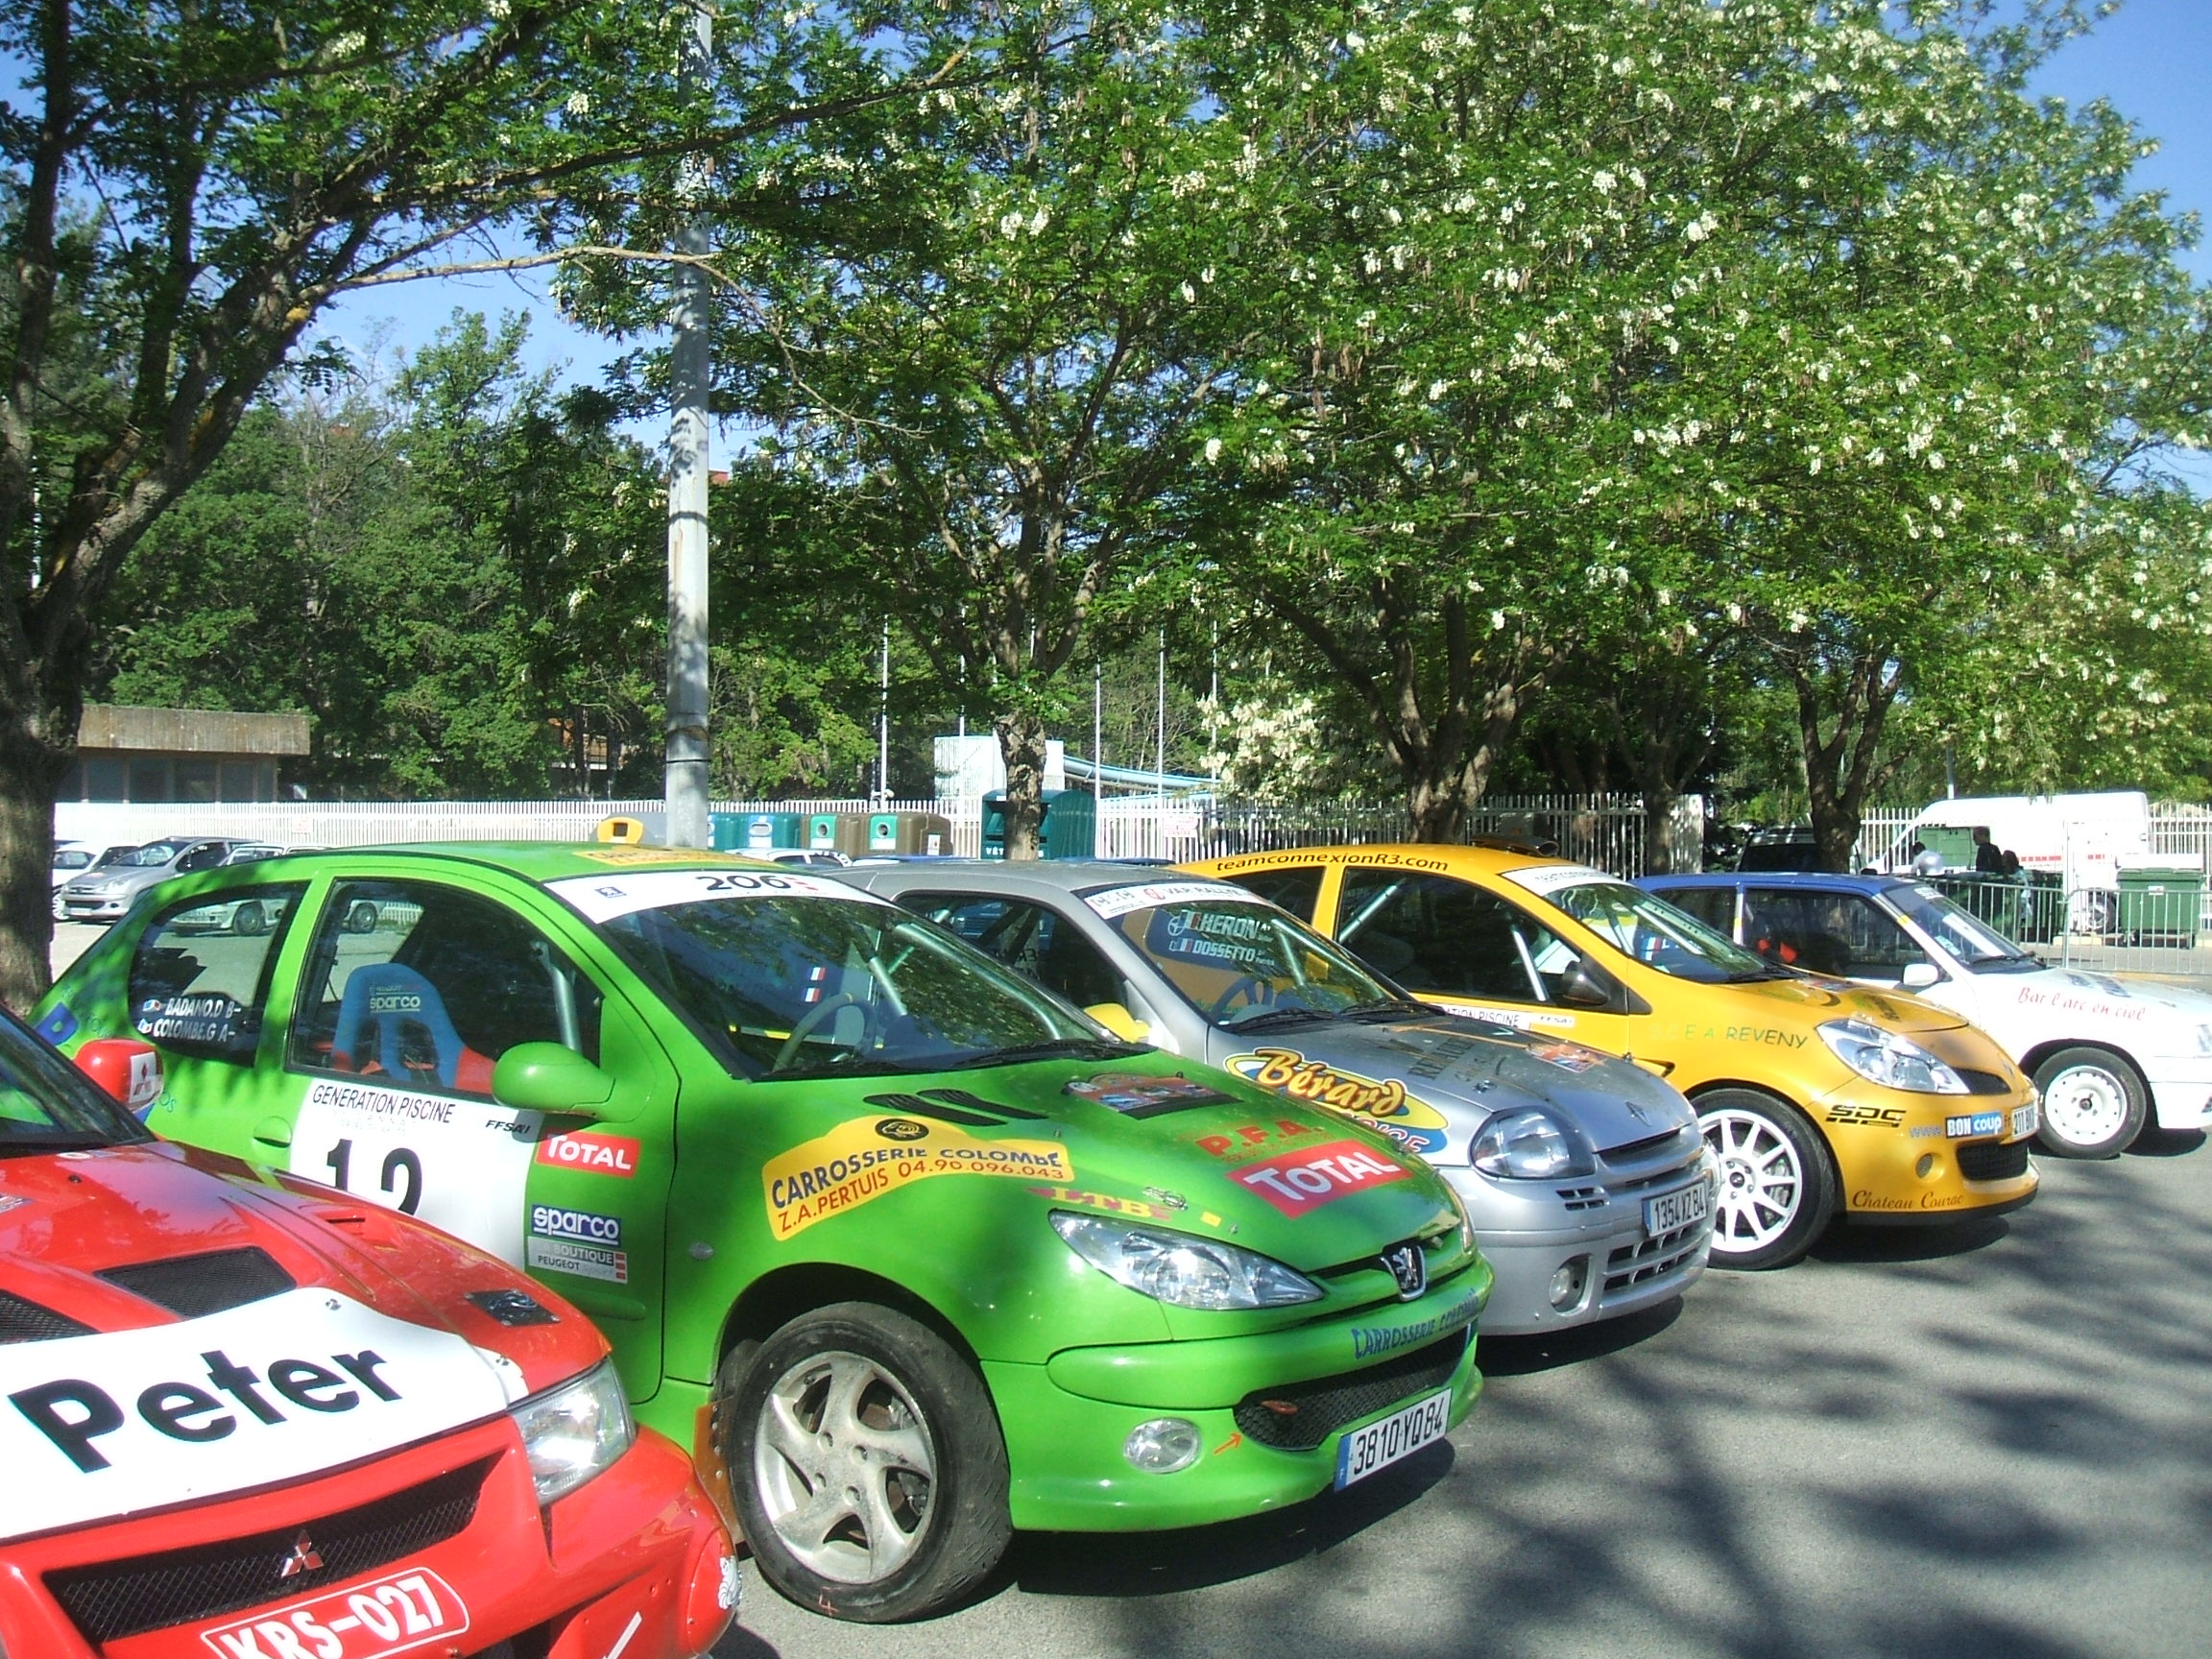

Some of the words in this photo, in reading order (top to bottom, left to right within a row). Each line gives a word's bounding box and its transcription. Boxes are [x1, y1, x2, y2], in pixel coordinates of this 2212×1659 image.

[696, 875, 792, 891] 206
[1199, 913, 1260, 940] HERON
[1191, 940, 1256, 963] DOSSETTO
[370, 996, 421, 1013] sparco
[1255, 1047, 1407, 1118] Bérard
[313, 1085, 398, 1116] GENERATION
[397, 1096, 456, 1123] PISCINE
[1946, 1116, 1971, 1137] BON
[1973, 1115, 2003, 1136] coup
[546, 1133, 632, 1170] TOTAL
[771, 1147, 928, 1209] CARROSSERIE
[940, 1148, 1063, 1167] COLOMBE
[1243, 1151, 1401, 1201] TOTAL
[533, 1206, 619, 1239] sparco
[538, 1255, 581, 1270] PEUGEOT
[554, 1243, 614, 1263] BOUTIQUE
[7, 1349, 403, 1474] Peter
